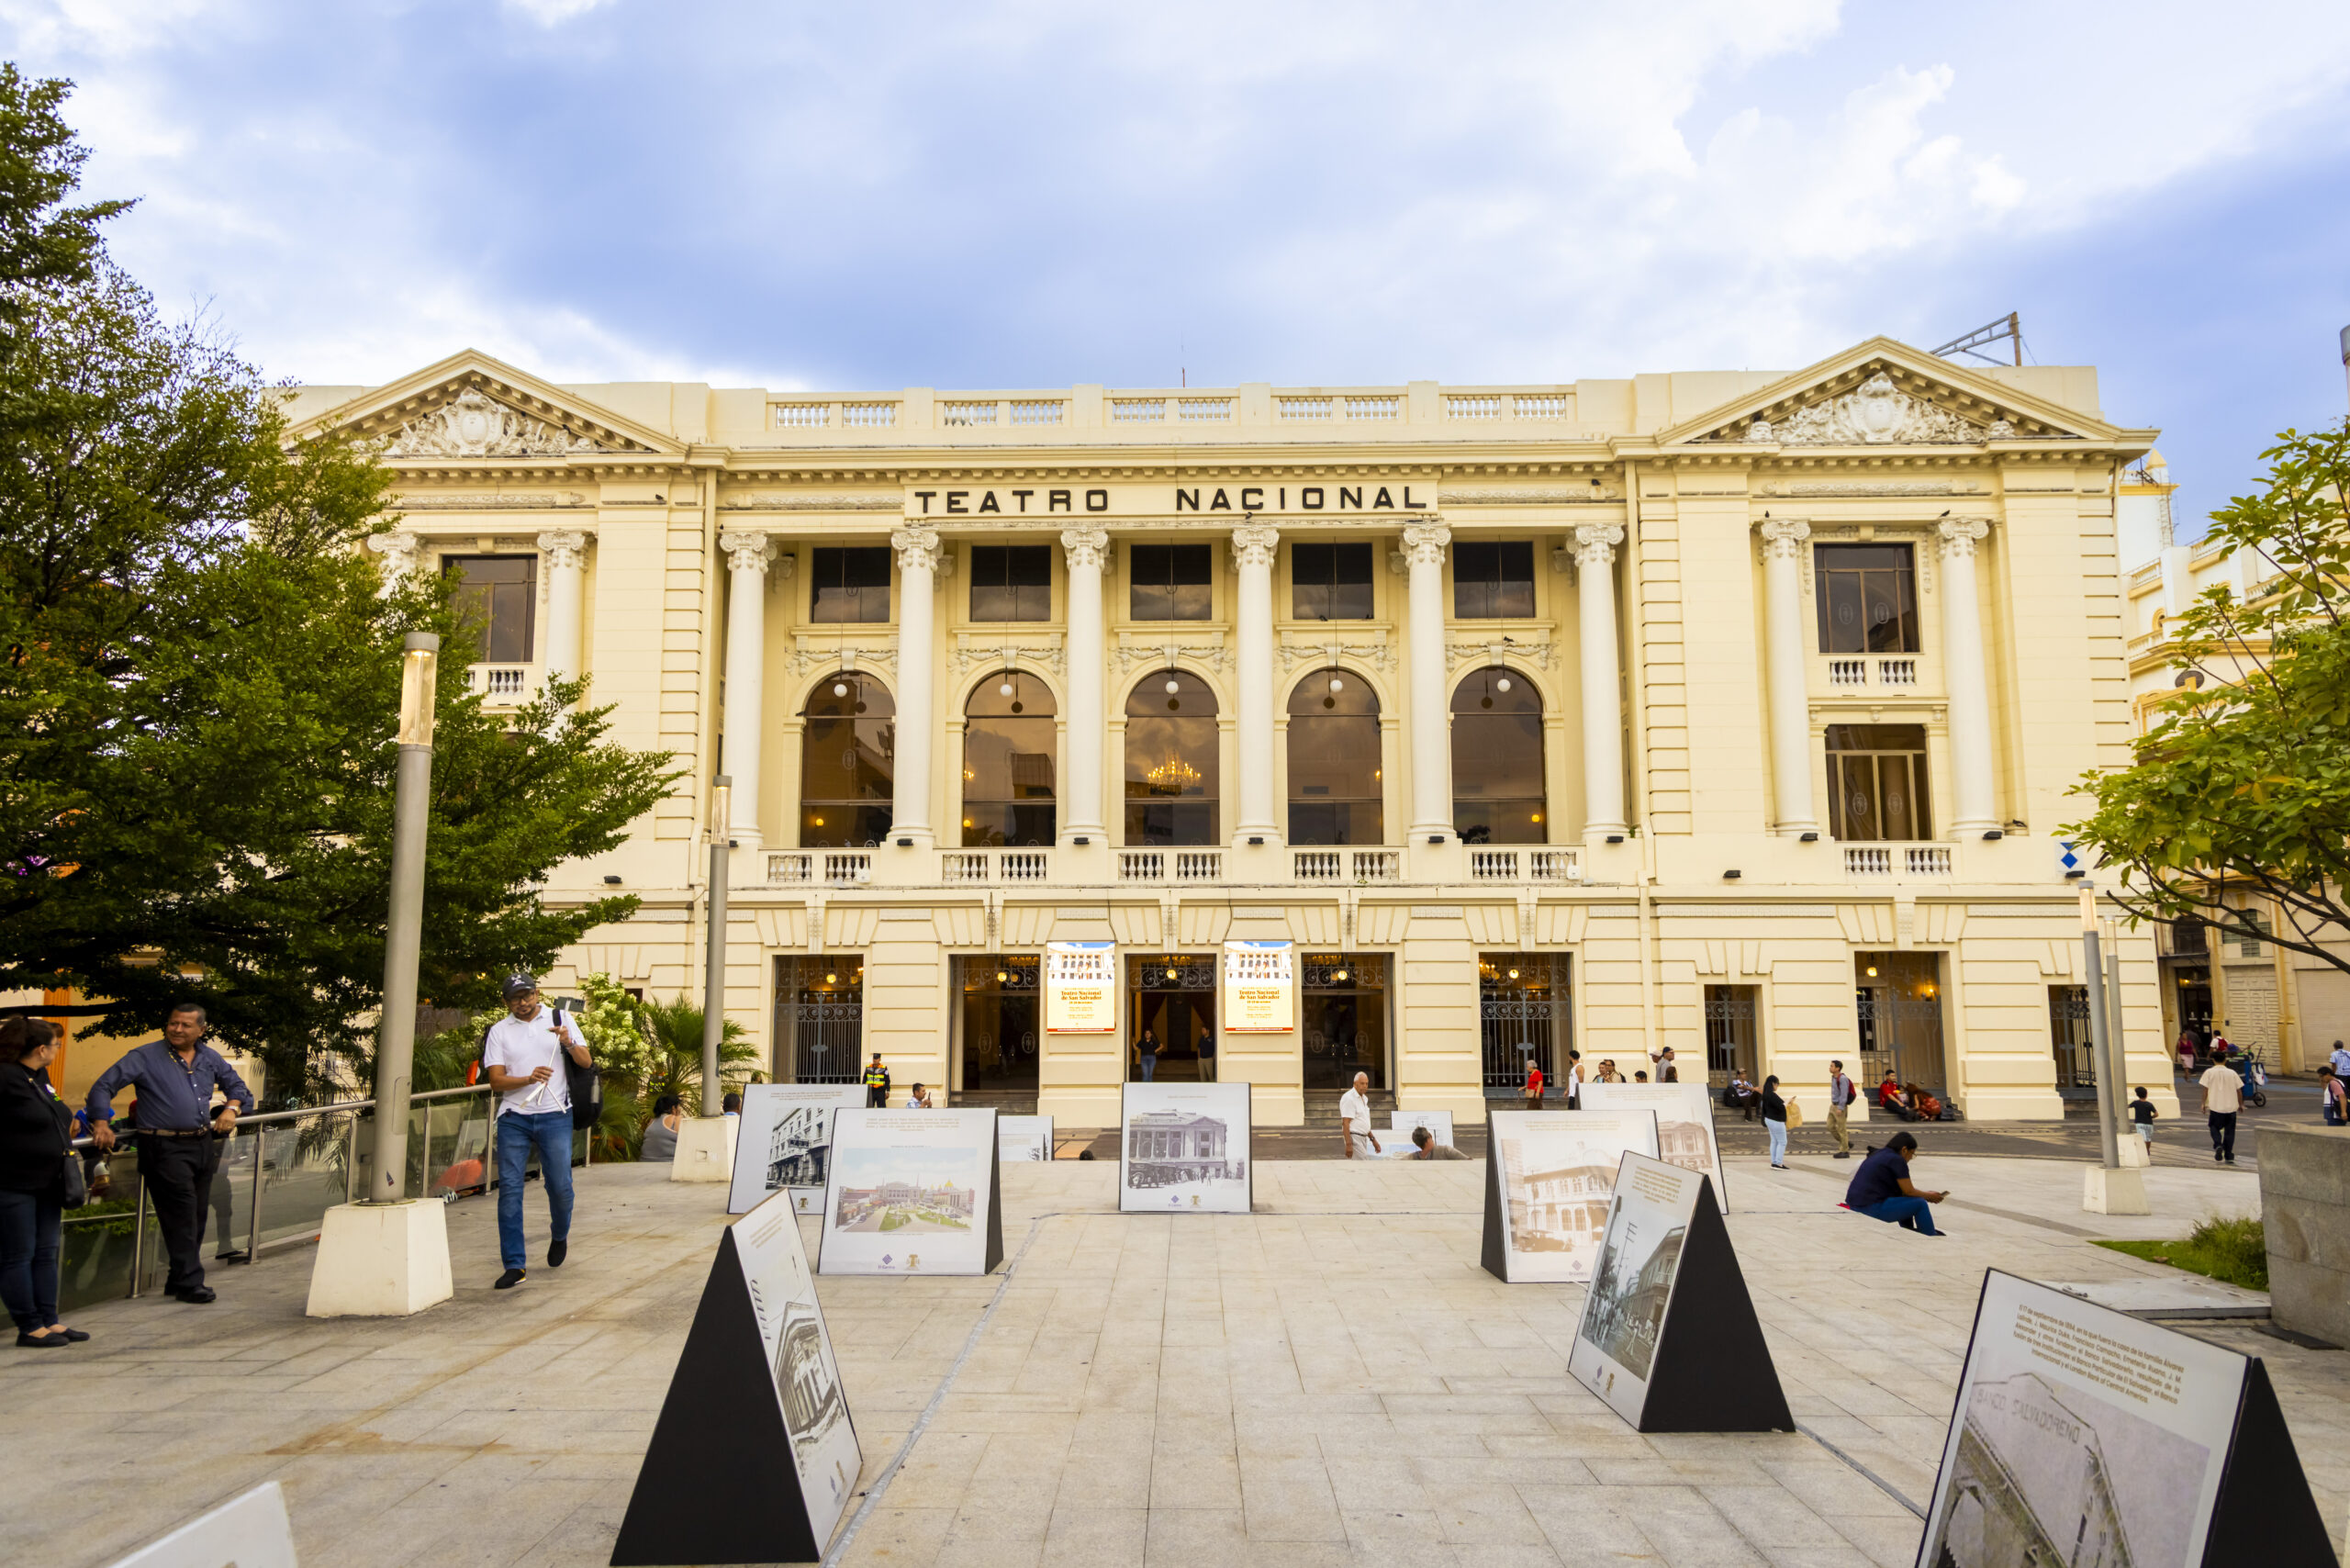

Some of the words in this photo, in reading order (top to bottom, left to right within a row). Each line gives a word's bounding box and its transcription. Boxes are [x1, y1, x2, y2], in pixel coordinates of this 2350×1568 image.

[914, 489, 1109, 514] TEATRO
[1176, 486, 1427, 511] NACIONAL
[2034, 1311, 2058, 1324] septiembre
[2088, 1331, 2098, 1340] que
[2098, 1333, 2111, 1344] fuera
[2117, 1342, 2130, 1351] casa
[2144, 1351, 2163, 1364] familia
[2073, 1335, 2095, 1349] Francisco
[2031, 1348, 2061, 1366] Internacional
[2070, 1364, 2087, 1377] London
[2087, 1372, 2099, 1383] Bank
[2107, 1380, 2125, 1394] Central
[2076, 1357, 2091, 1368] Banco
[2092, 1363, 2116, 1379] Particular
[2117, 1374, 2123, 1383] de
[2160, 1391, 2178, 1405] Banco
[2085, 1350, 2100, 1361] Banco
[2137, 1372, 2163, 1387] resultado
[2165, 1383, 2172, 1391] de
[1976, 1388, 2006, 1411] BANCO
